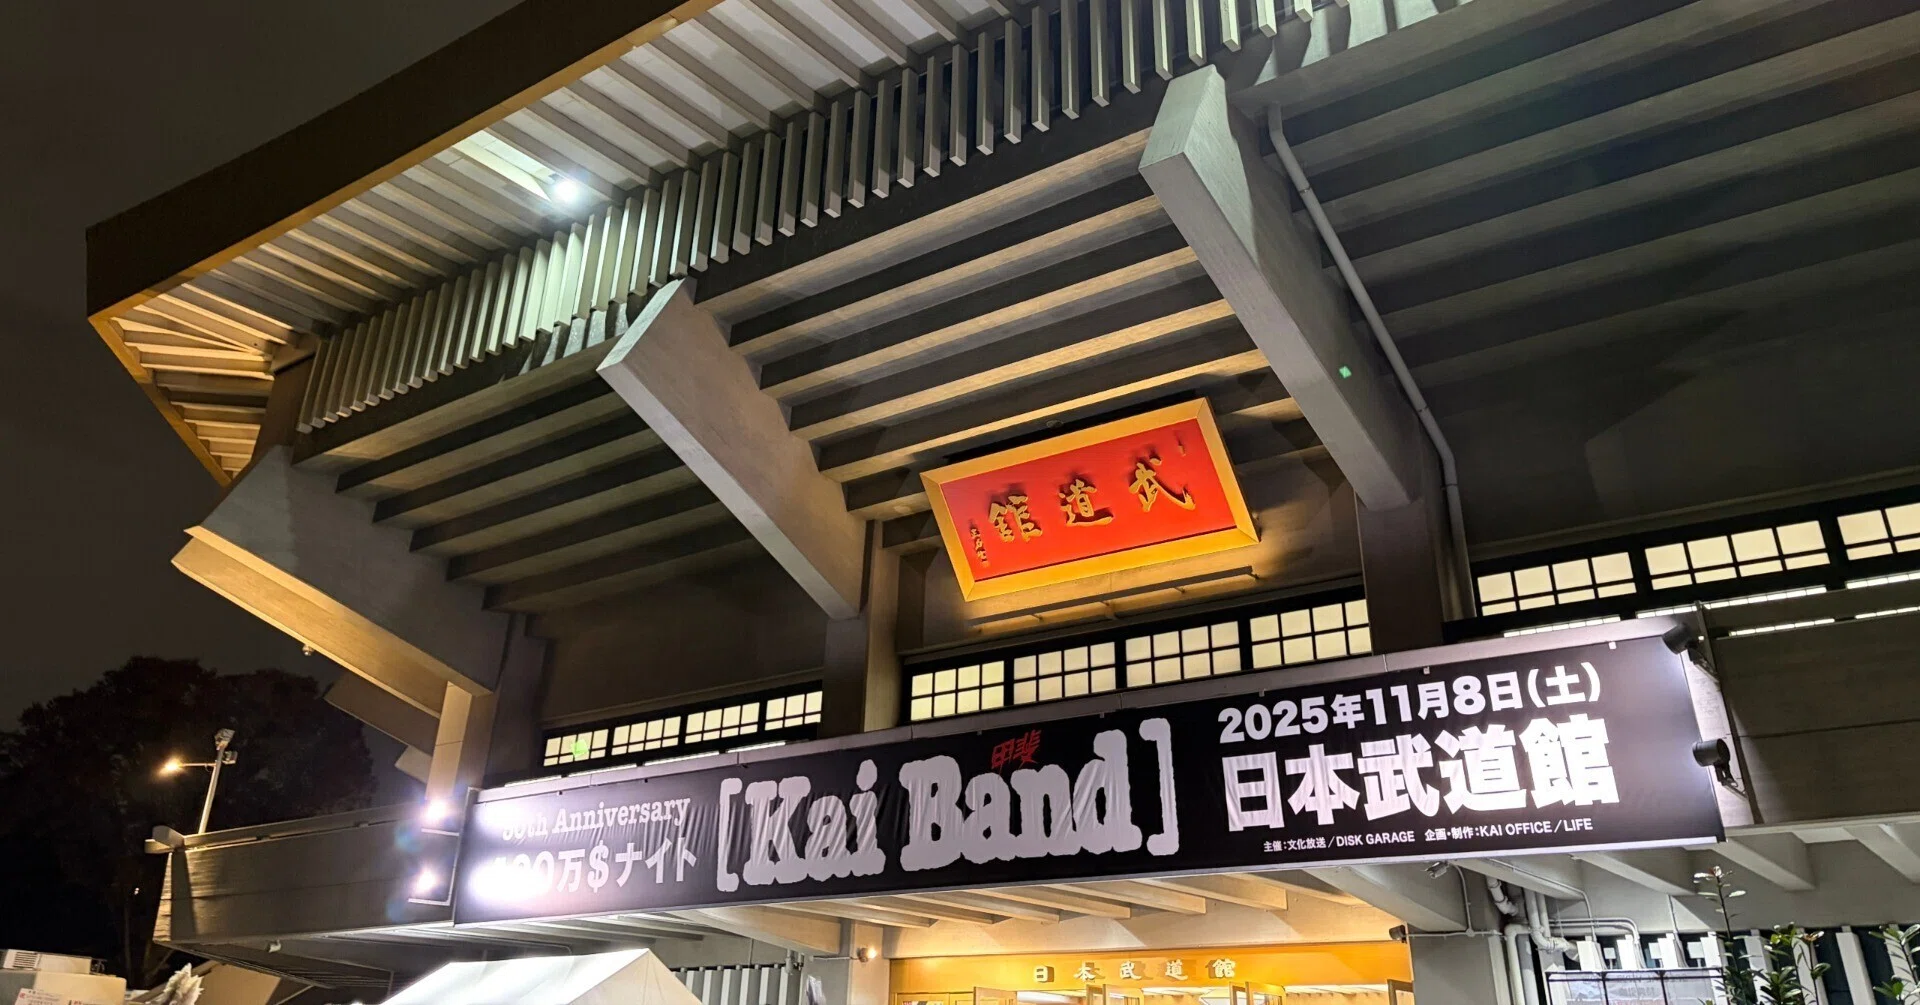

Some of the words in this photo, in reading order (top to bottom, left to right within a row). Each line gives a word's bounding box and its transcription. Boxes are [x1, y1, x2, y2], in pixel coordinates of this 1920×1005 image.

[988, 456, 1196, 543] 武道館
[1217, 661, 1602, 744] 2025年11月8日(土)
[1221, 712, 1620, 832] 日本武道館
[551, 797, 690, 834] Anniversary
[1365, 830, 1416, 845] GARAGE
[492, 836, 697, 895] 0万$ナイト
[1034, 958, 1236, 983] 日本武道館
